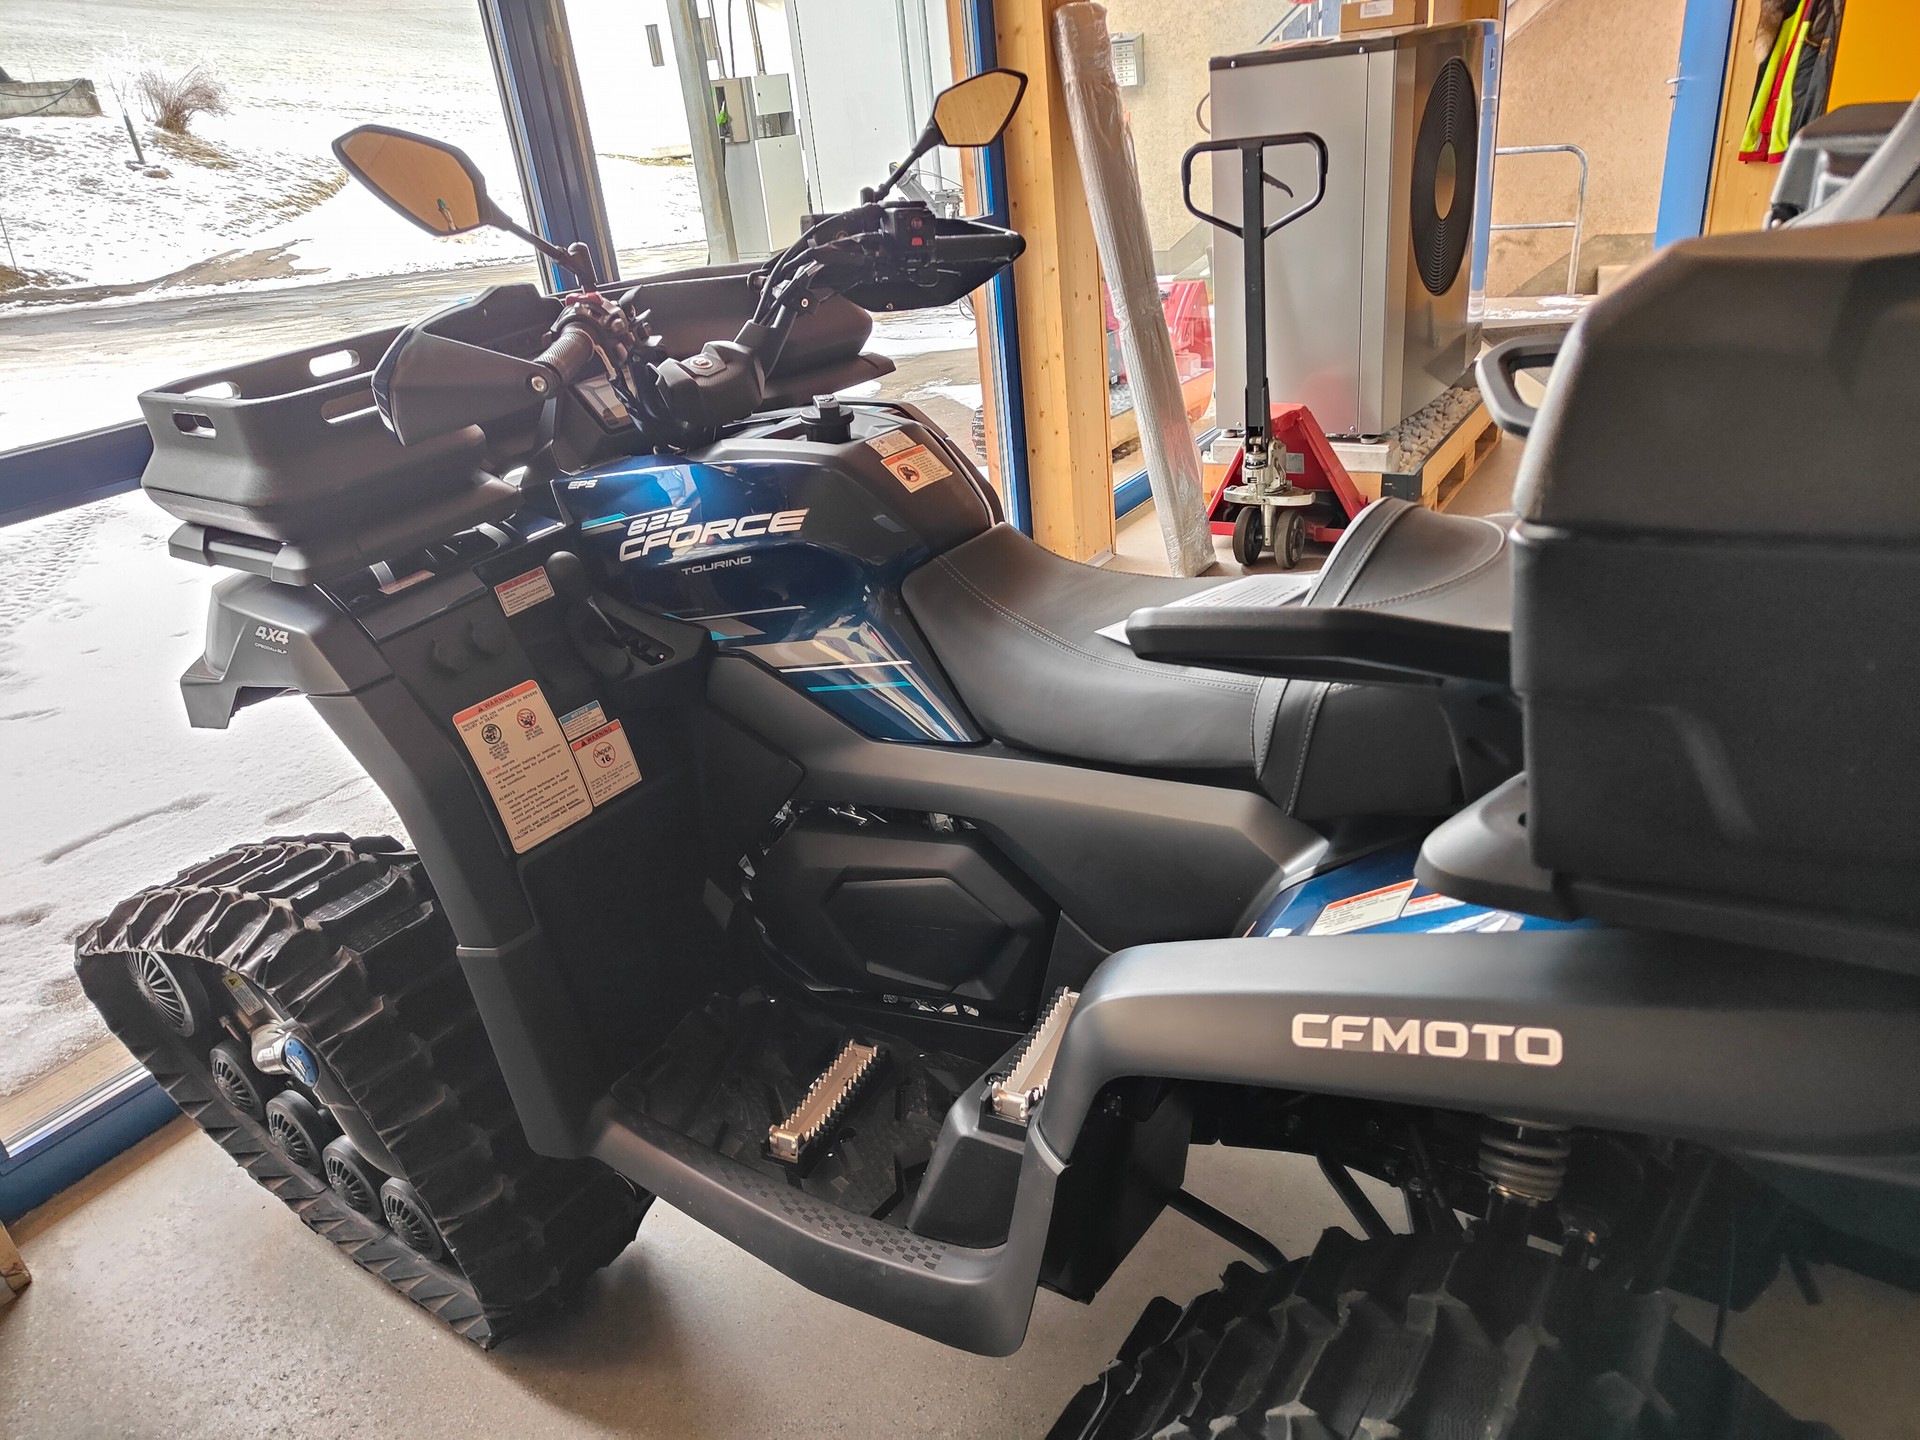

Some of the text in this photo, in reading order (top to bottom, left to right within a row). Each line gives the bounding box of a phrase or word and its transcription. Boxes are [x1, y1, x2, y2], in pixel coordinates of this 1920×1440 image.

[568, 480, 598, 489] EPS
[627, 508, 692, 536] 625
[619, 508, 810, 562] CFORCE
[681, 556, 752, 576] TOURING
[484, 691, 514, 708] WARNING
[570, 707, 588, 718] NOTICE
[586, 726, 612, 743] WARNING
[594, 745, 611, 757] UNDER
[600, 754, 611, 764] 16
[1292, 1013, 1563, 1066] CFMOTO
